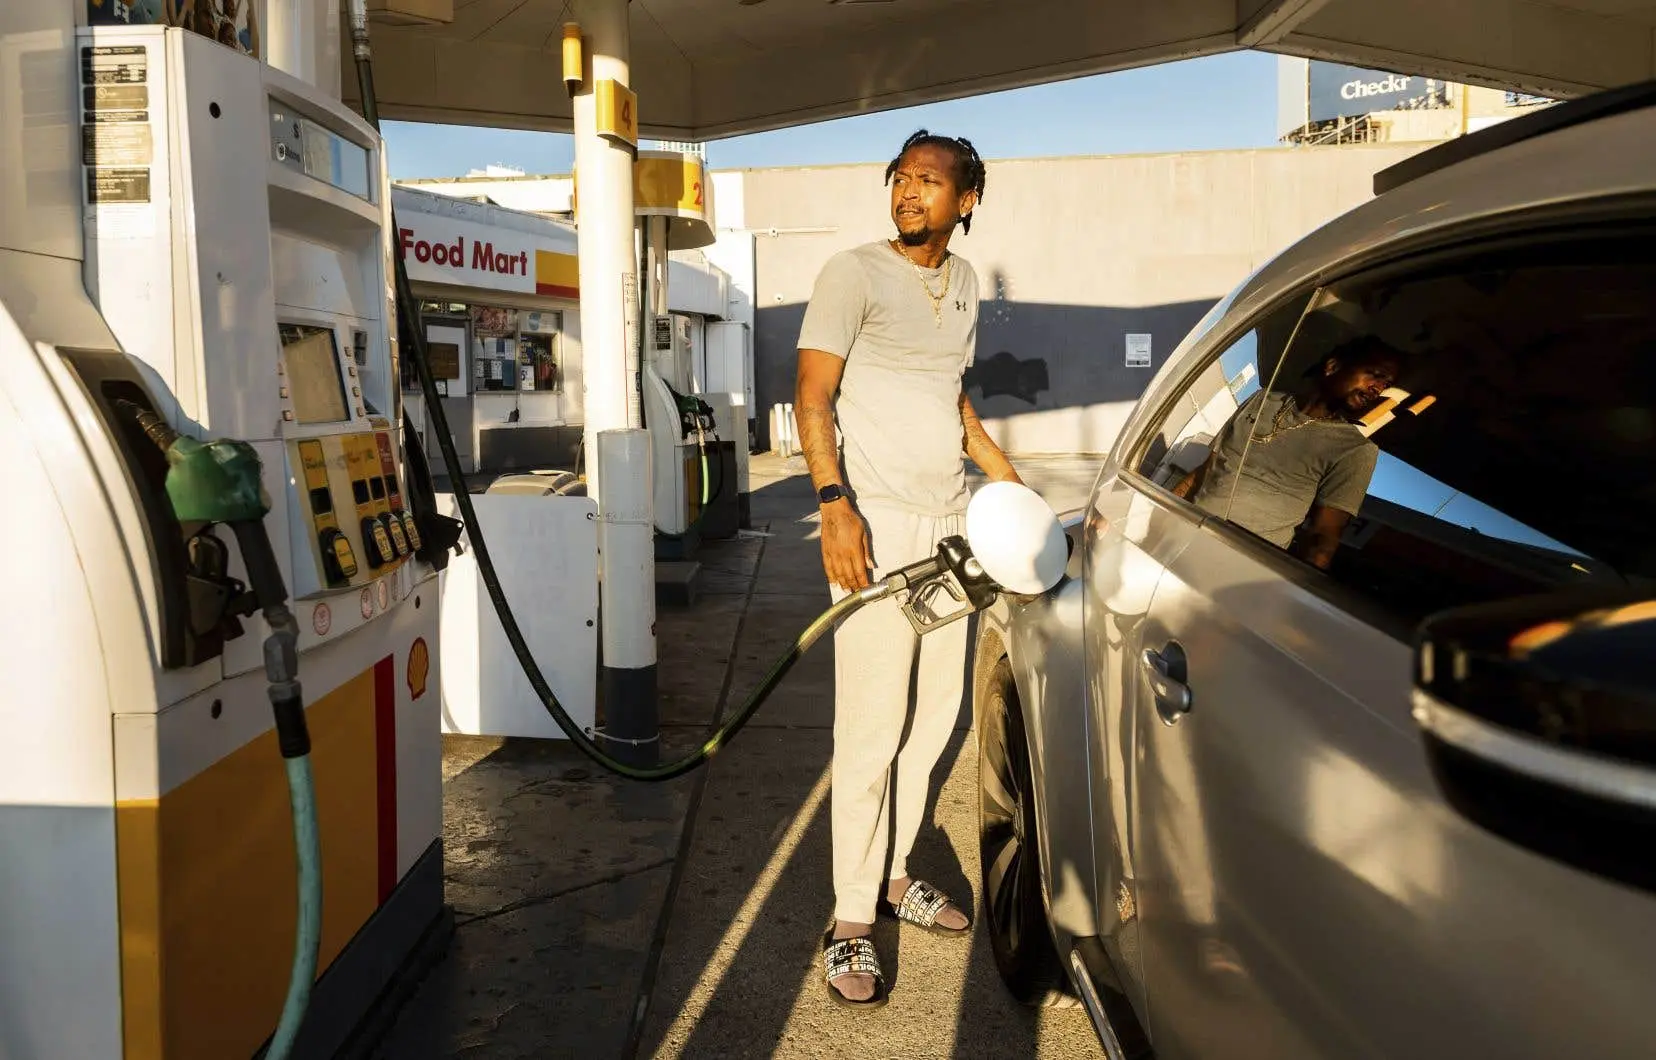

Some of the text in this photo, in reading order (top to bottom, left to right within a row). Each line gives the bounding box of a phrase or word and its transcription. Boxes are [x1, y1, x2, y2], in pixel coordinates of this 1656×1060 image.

[1341, 75, 1411, 99] Checkr
[621, 100, 632, 131] 4
[692, 182, 703, 206] 2
[399, 228, 528, 276] Food Mart
